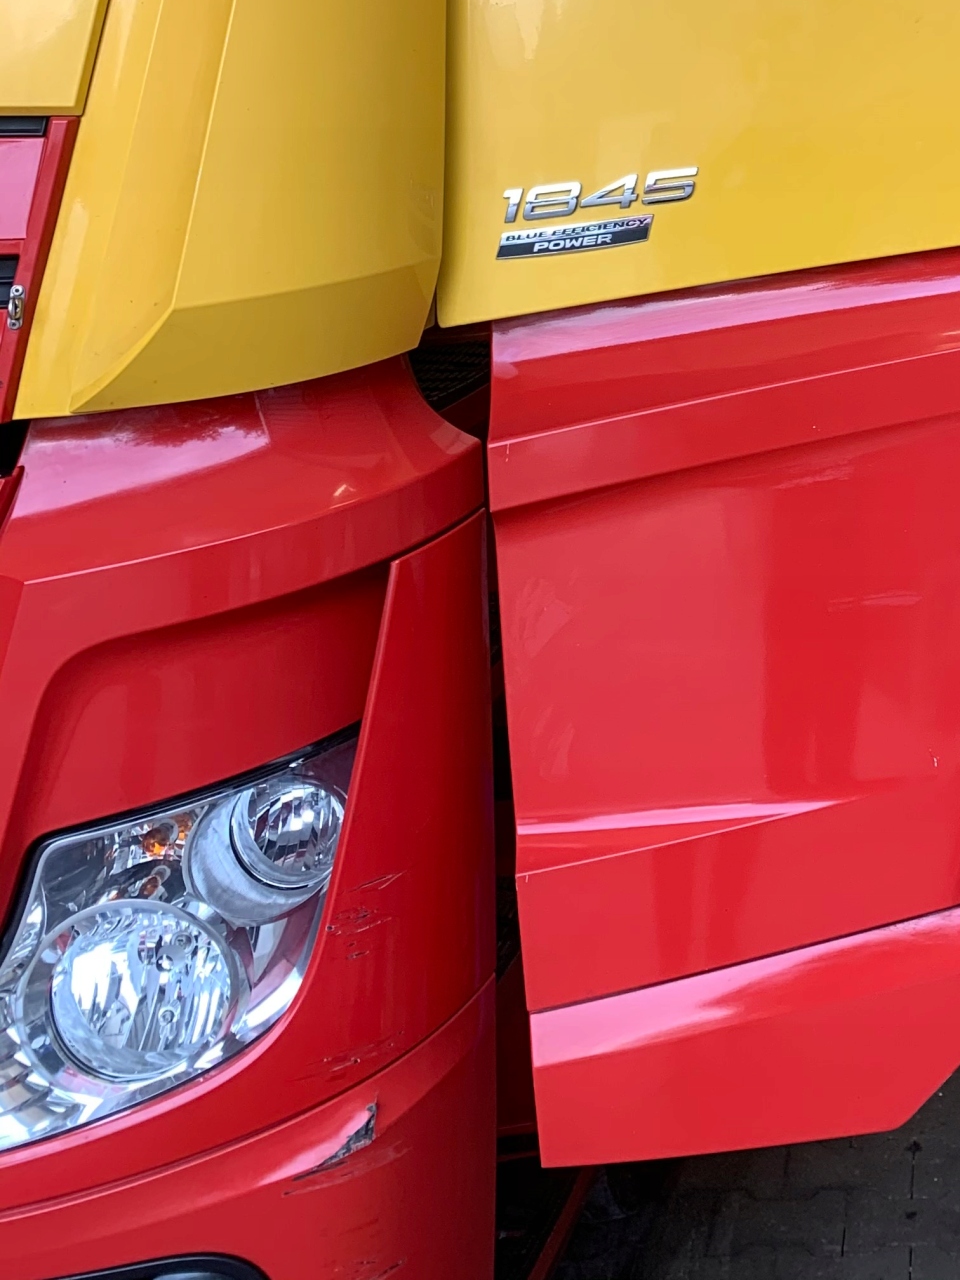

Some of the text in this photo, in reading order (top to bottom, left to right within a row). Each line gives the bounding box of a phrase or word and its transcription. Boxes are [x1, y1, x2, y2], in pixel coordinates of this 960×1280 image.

[503, 167, 698, 223] 1845
[552, 218, 647, 237] EFFICIENCY
[533, 234, 612, 252] POWER
